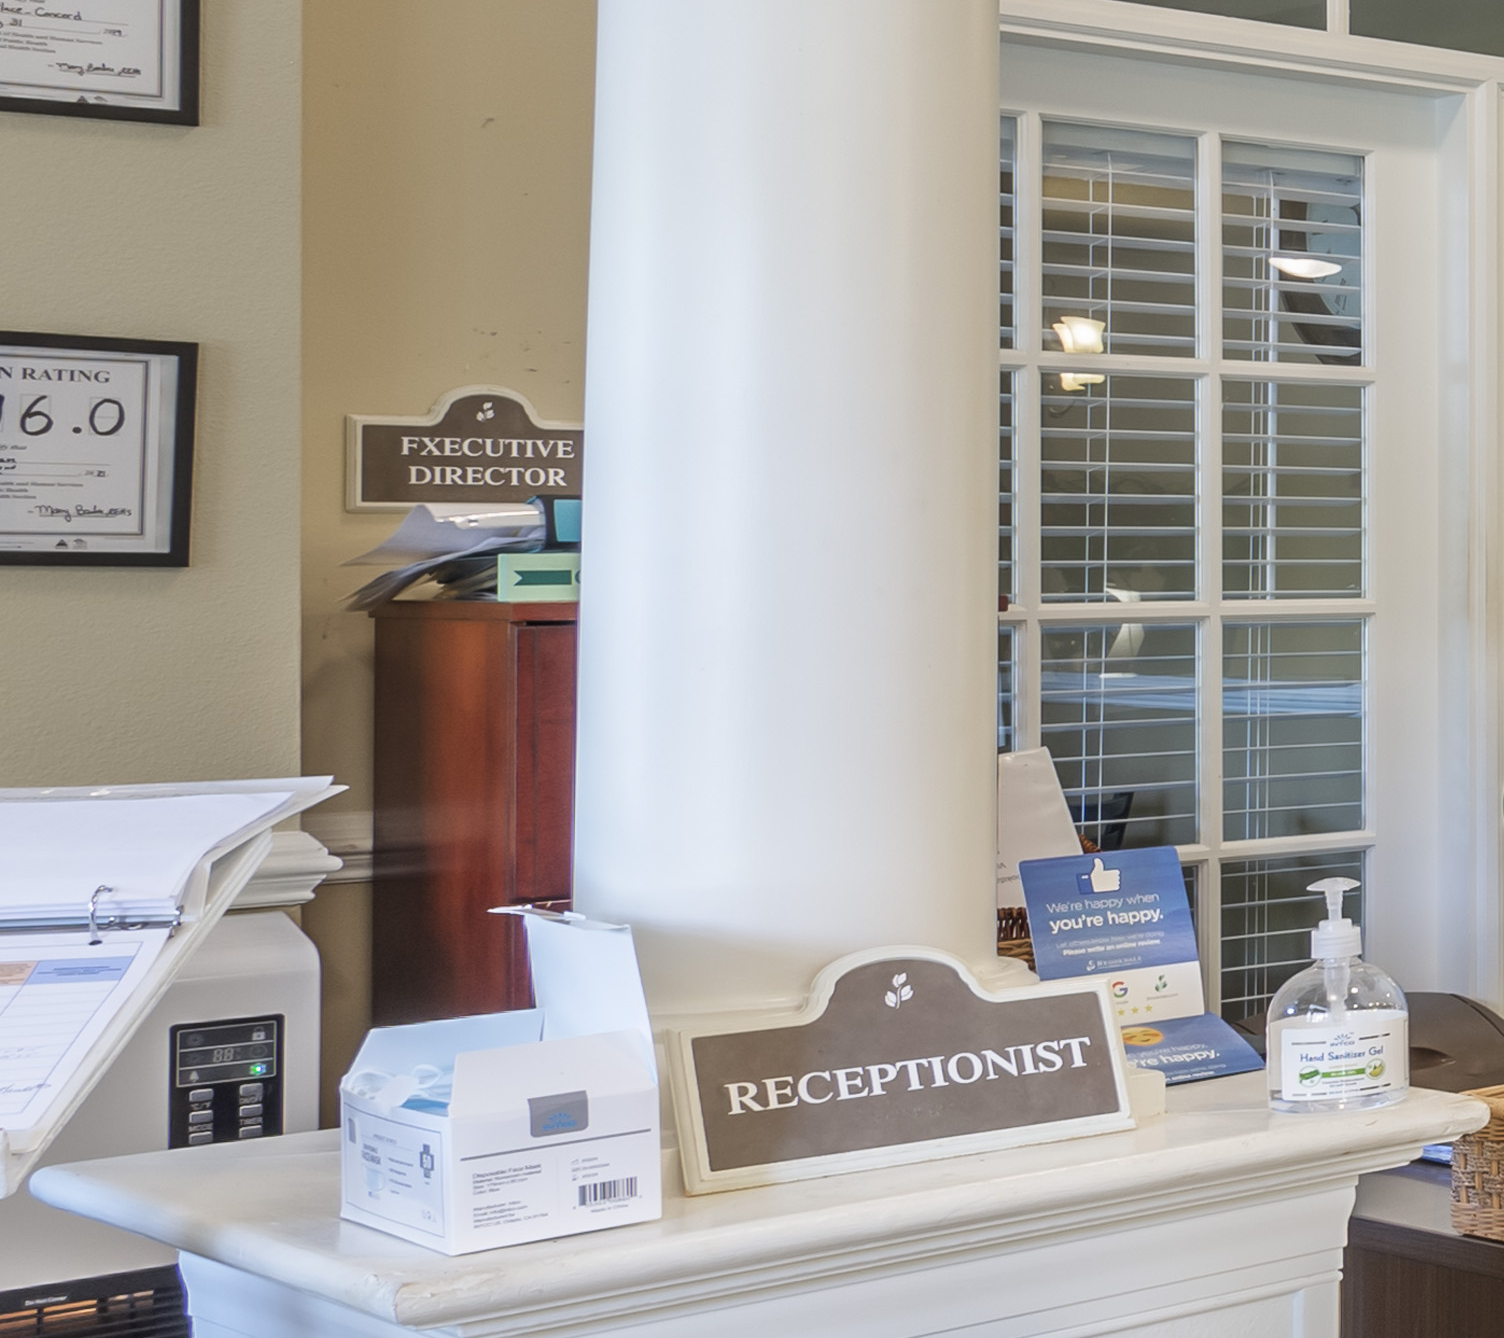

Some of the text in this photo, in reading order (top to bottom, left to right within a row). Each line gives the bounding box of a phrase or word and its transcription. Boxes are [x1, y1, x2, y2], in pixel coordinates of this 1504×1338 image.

[34, 6, 83, 21] Concord
[22, 367, 111, 384] RATING
[408, 465, 567, 487] DIRECTOR
[1046, 892, 1160, 914] We're happy when
[1049, 907, 1164, 935] you're happy.
[1062, 948, 1086, 956] Please
[1159, 1049, 1221, 1064] happy.
[1300, 1045, 1384, 1062] Hand Sanitizer Gel
[724, 1035, 1091, 1116] RECEPTIONIST
